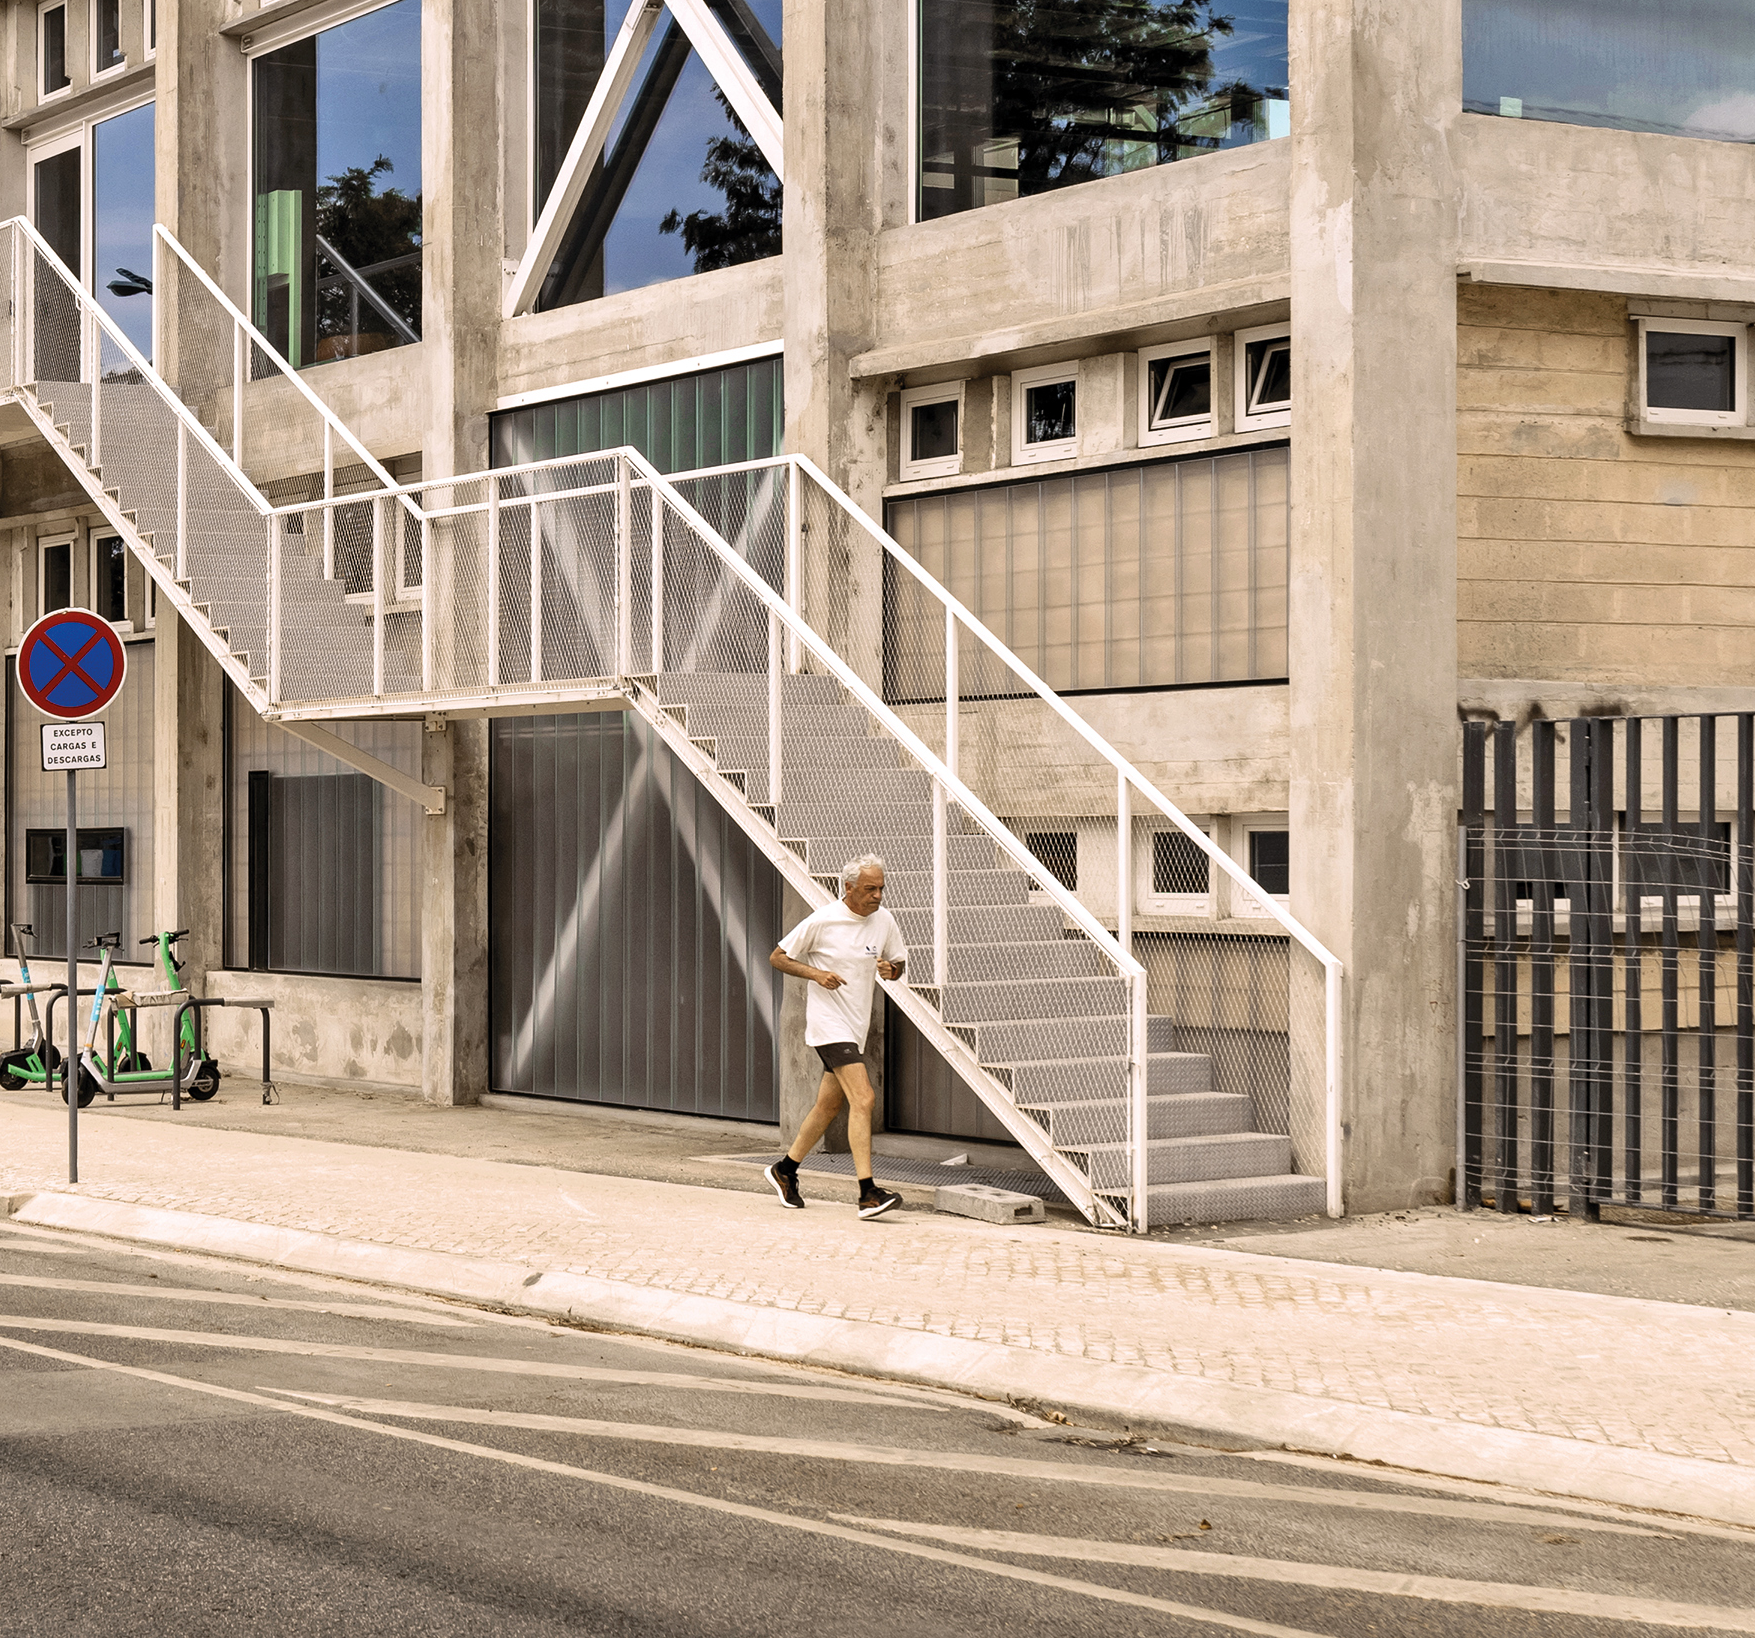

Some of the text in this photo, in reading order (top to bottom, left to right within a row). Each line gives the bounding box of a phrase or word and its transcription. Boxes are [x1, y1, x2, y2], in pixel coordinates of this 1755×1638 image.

[53, 728, 93, 737] EXCEPTO
[50, 741, 97, 751] CARGAS E
[47, 754, 101, 765] DESCARGAS
